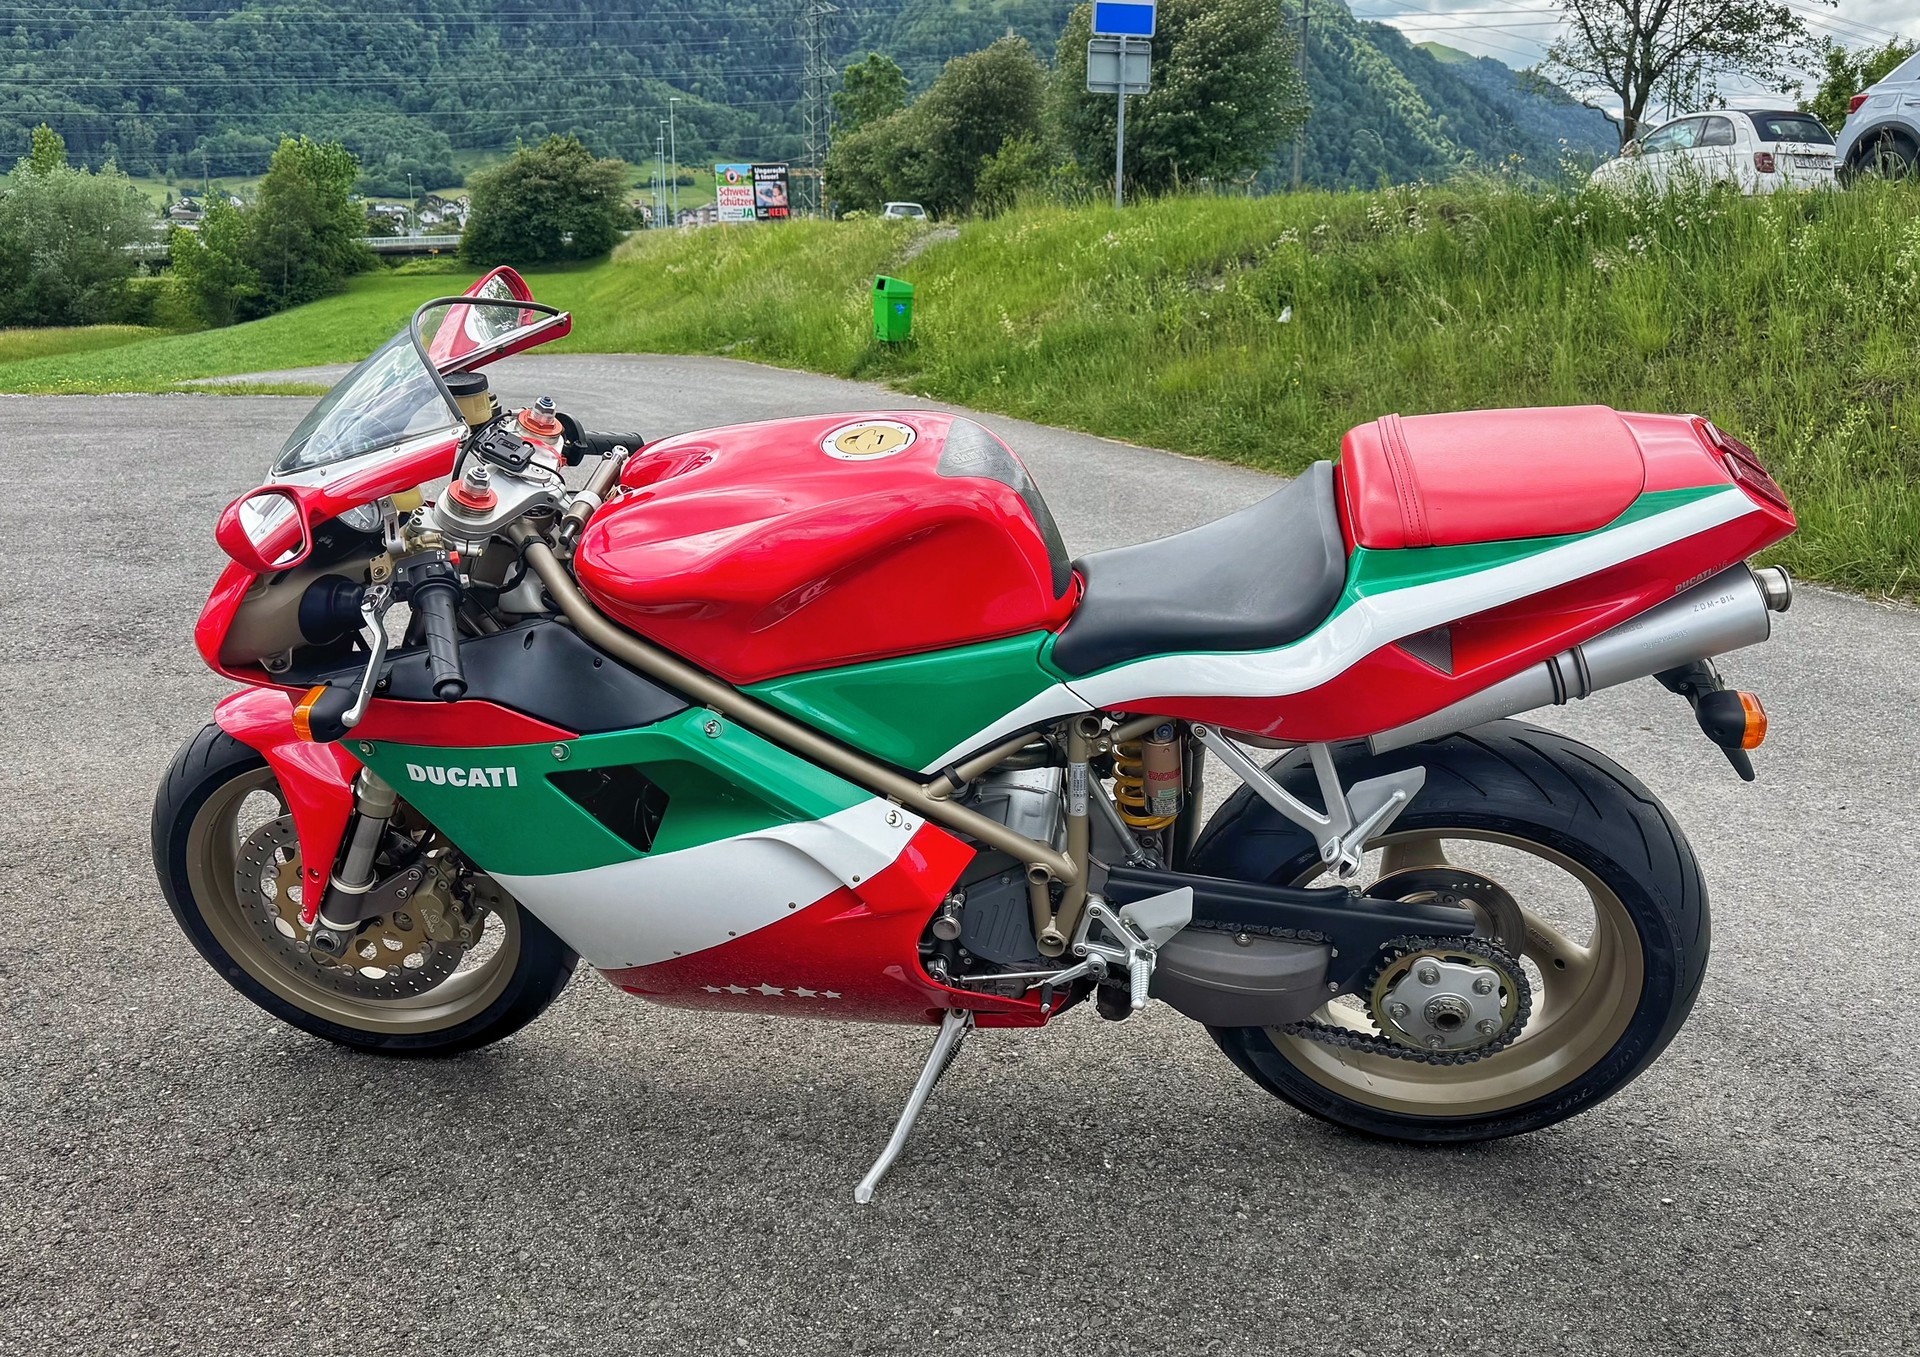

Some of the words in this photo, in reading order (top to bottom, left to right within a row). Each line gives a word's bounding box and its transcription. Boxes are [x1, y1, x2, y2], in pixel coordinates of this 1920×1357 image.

[719, 187, 750, 196] Schweiz
[720, 197, 755, 206] schützen
[741, 208, 754, 218] JA
[768, 207, 789, 217] NEIN
[1674, 567, 1712, 593] DUCATI
[1712, 560, 1728, 574] 916
[405, 763, 518, 787] DUCATI
